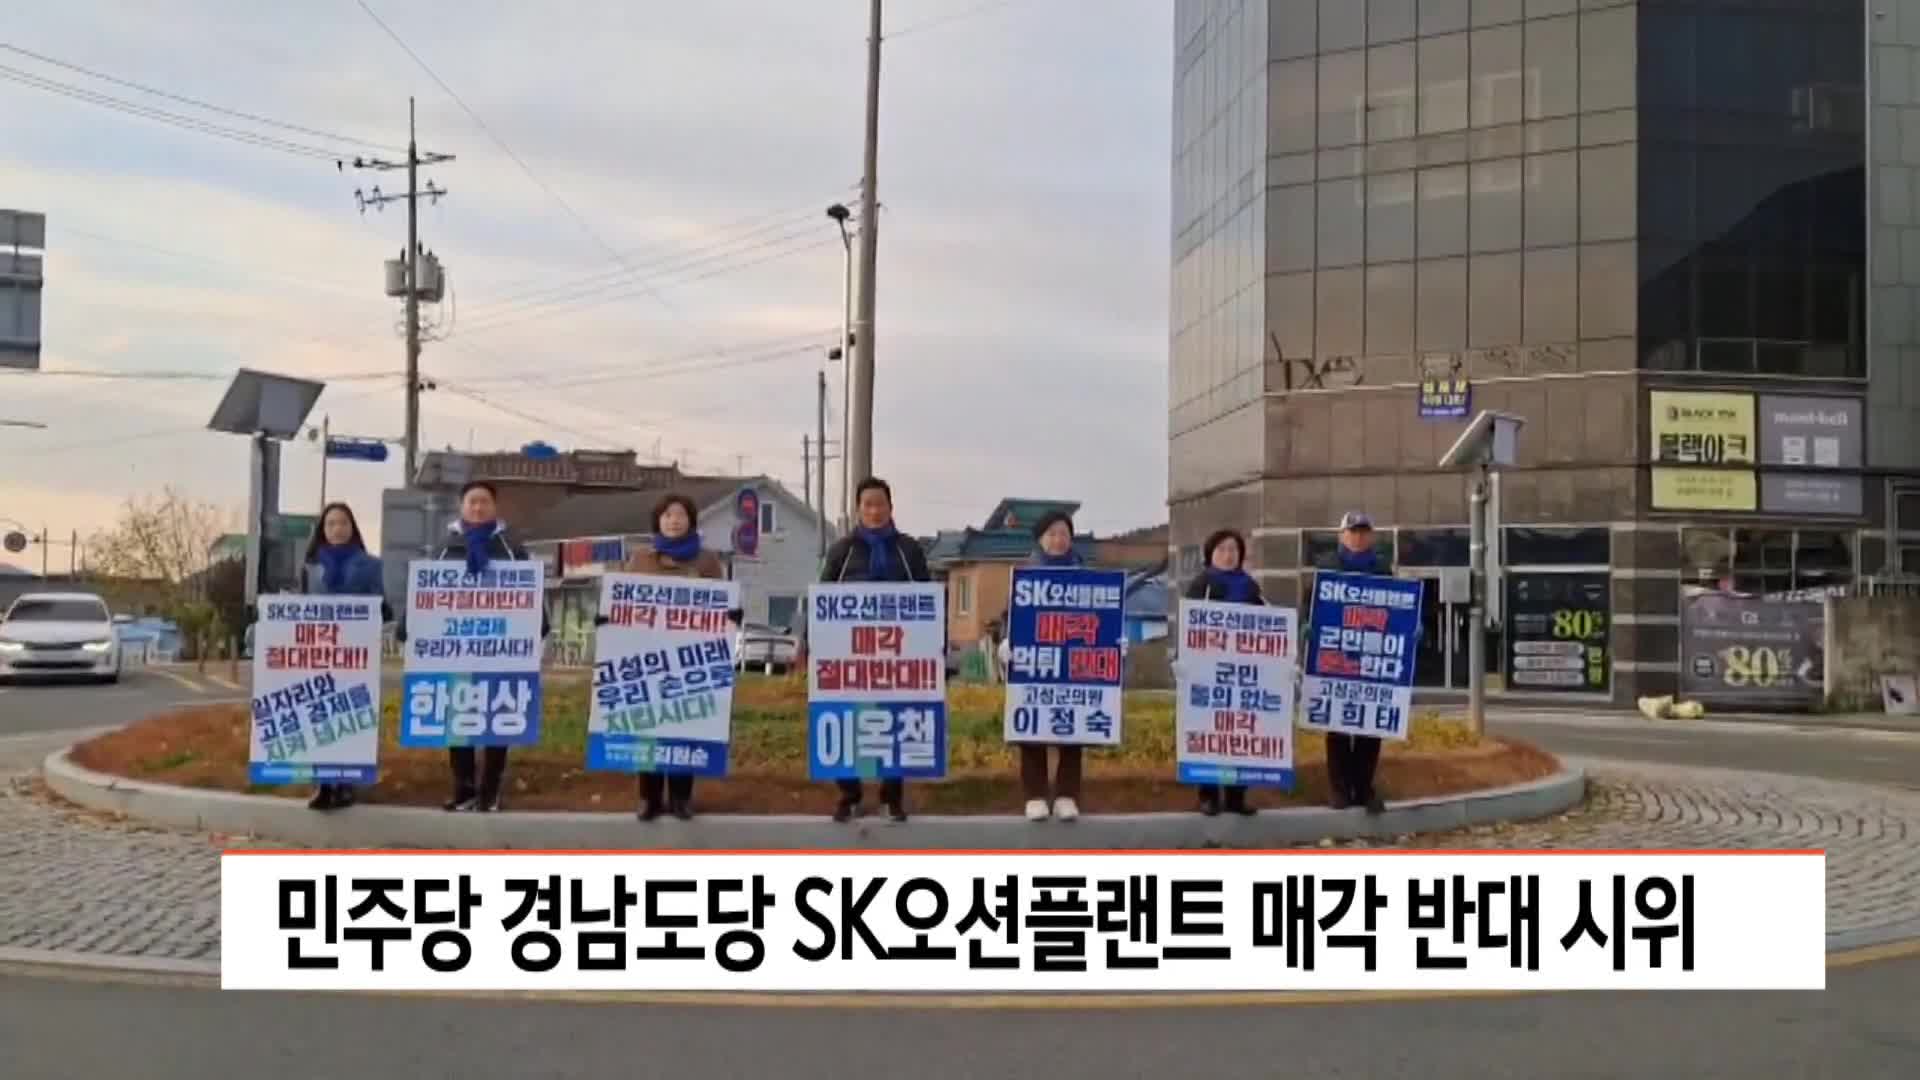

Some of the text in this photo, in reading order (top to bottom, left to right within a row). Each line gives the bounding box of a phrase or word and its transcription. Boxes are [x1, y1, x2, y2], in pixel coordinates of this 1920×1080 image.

[610, 603, 657, 629] 매각
[295, 622, 339, 646] 매각
[852, 625, 904, 656] 매각
[1187, 629, 1228, 651] 매각
[592, 638, 731, 687] 고성의 미래
[1013, 645, 1061, 678] 먹튀
[1216, 661, 1258, 687] 군민
[597, 664, 733, 710] 우리 손으로
[410, 679, 532, 736] 한영상
[1214, 710, 1256, 734] 매각
[256, 710, 301, 744] 고성
[817, 708, 935, 768] 이옥철
